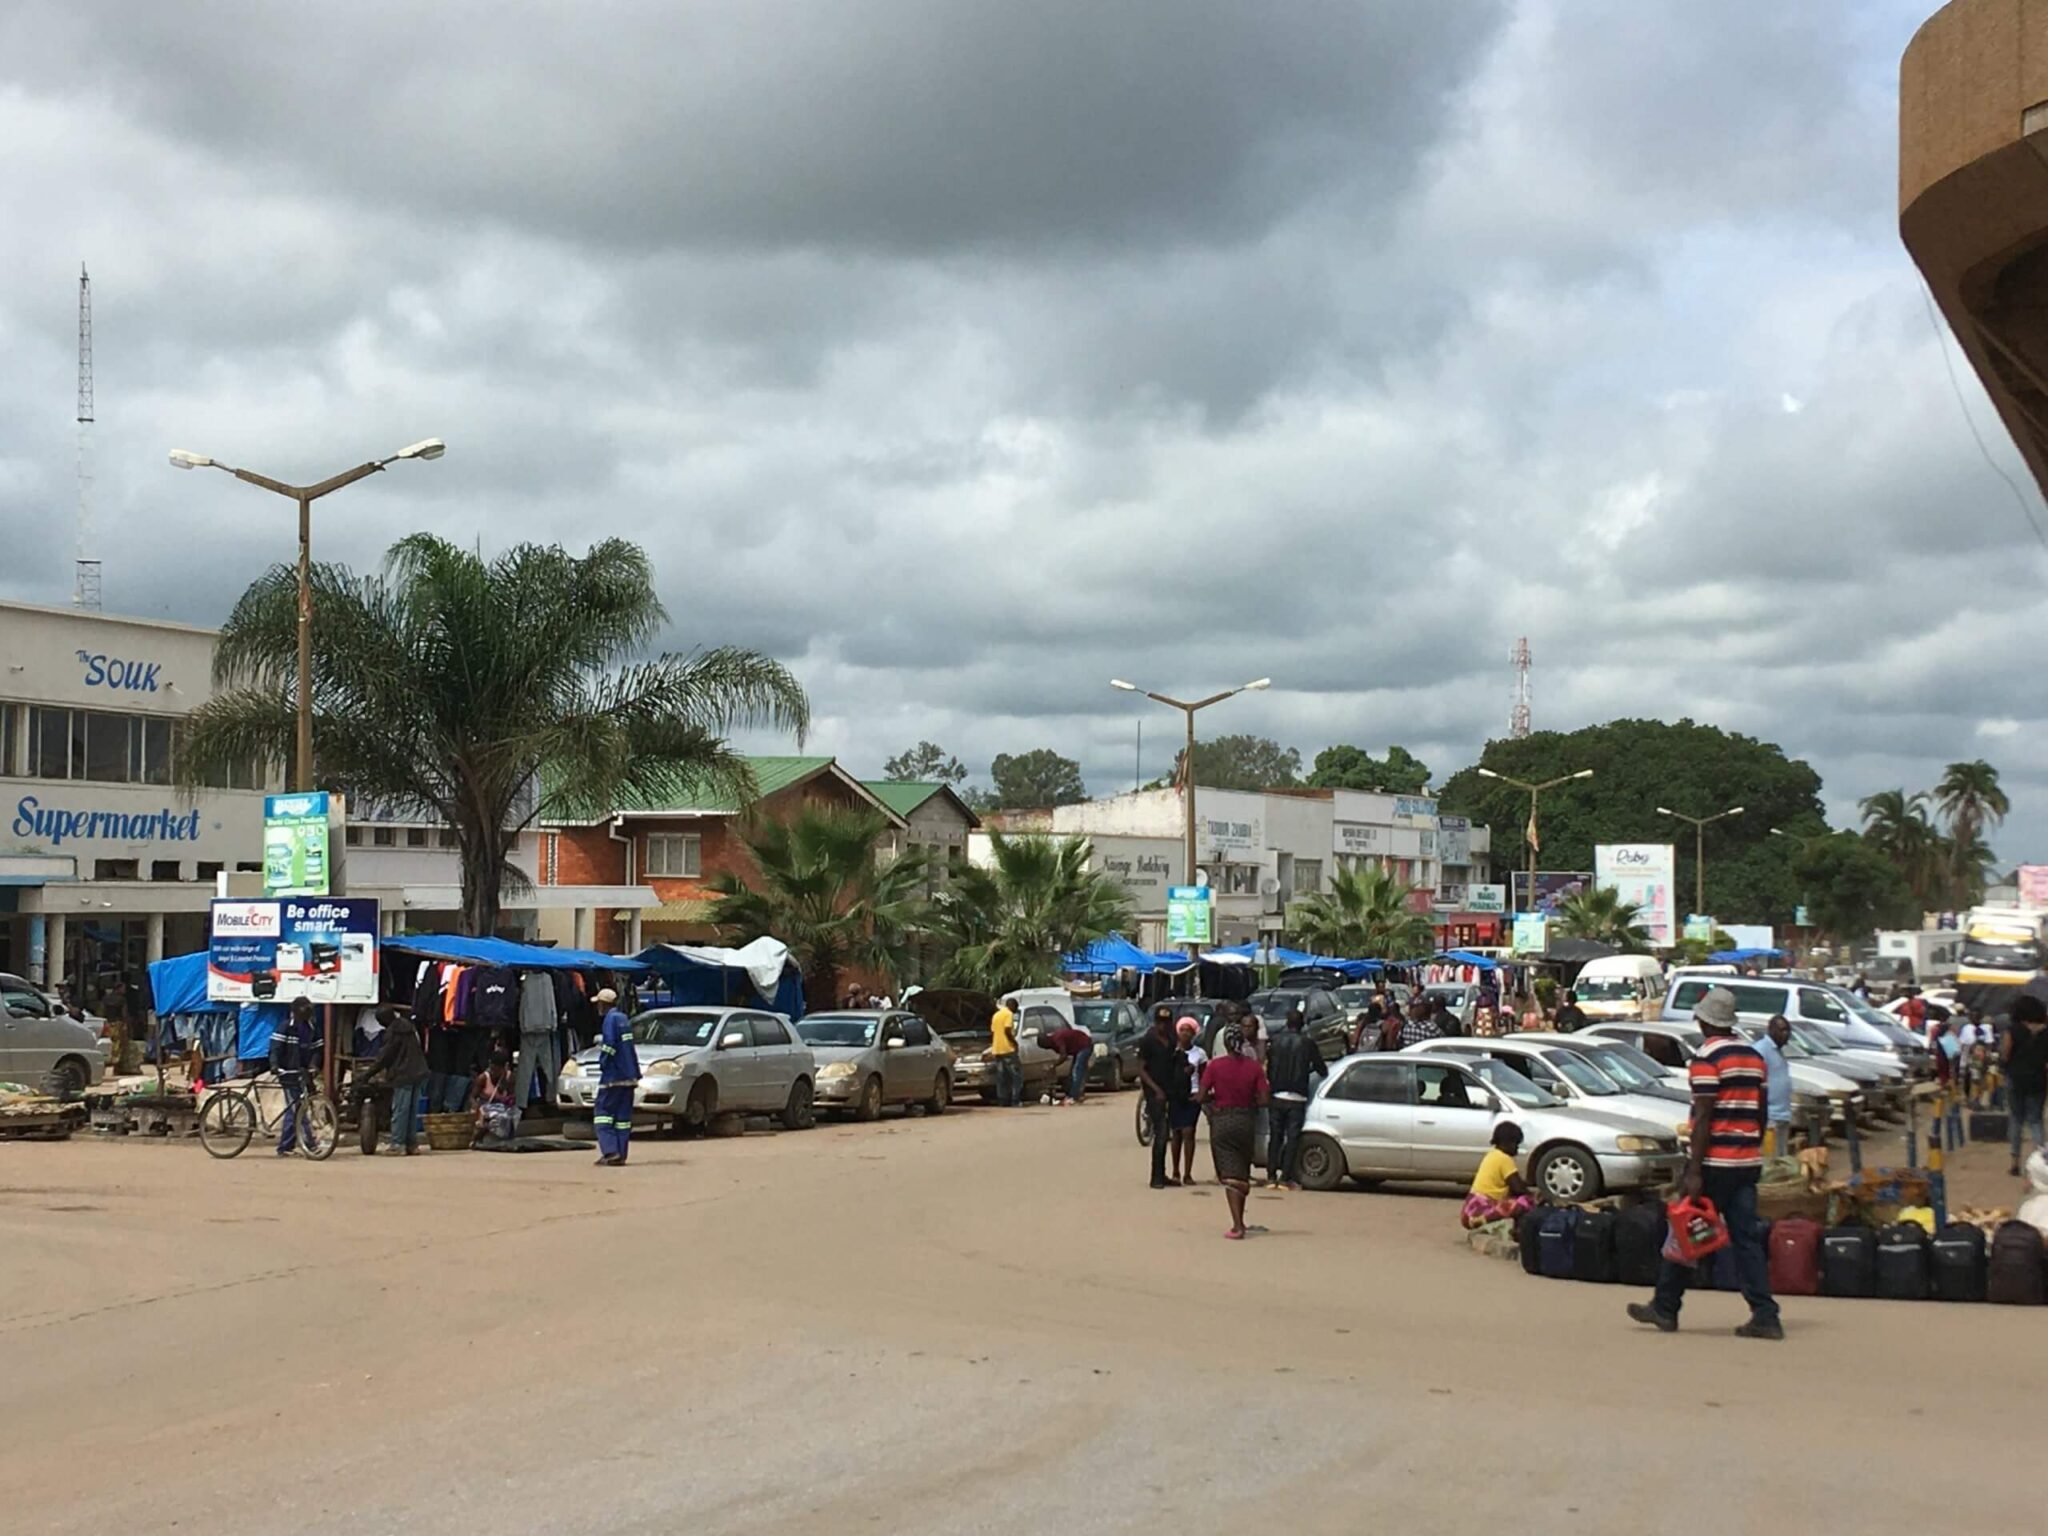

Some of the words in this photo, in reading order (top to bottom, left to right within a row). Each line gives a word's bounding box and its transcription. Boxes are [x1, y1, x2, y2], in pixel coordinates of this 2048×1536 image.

[85, 655, 162, 692] SOUK
[13, 796, 200, 845] Supermarket
[287, 904, 305, 919] Be
[308, 904, 350, 919] office
[294, 919, 348, 932] smart...
